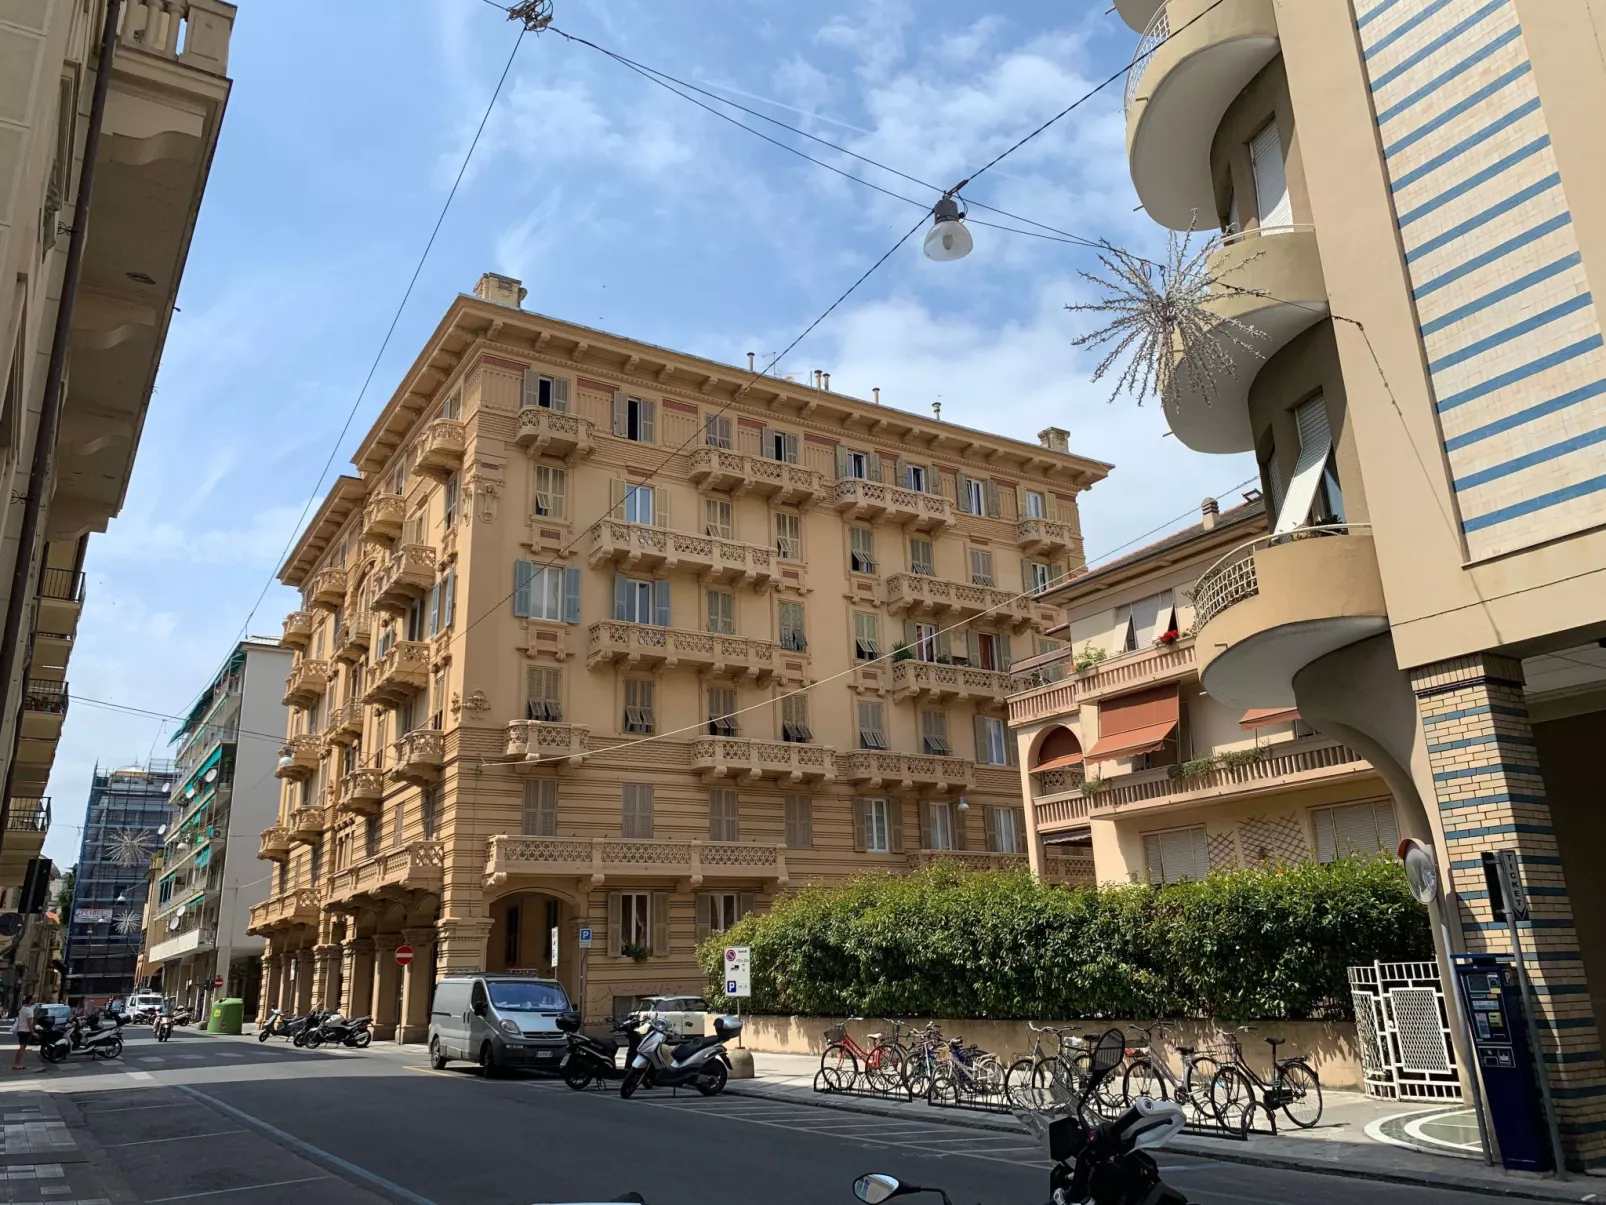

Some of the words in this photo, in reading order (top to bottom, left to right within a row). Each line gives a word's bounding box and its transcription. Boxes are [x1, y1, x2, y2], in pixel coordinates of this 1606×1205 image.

[1506, 854, 1522, 906] TICKET
[583, 930, 589, 939] P
[1505, 972, 1511, 983] P
[729, 981, 735, 991] P
